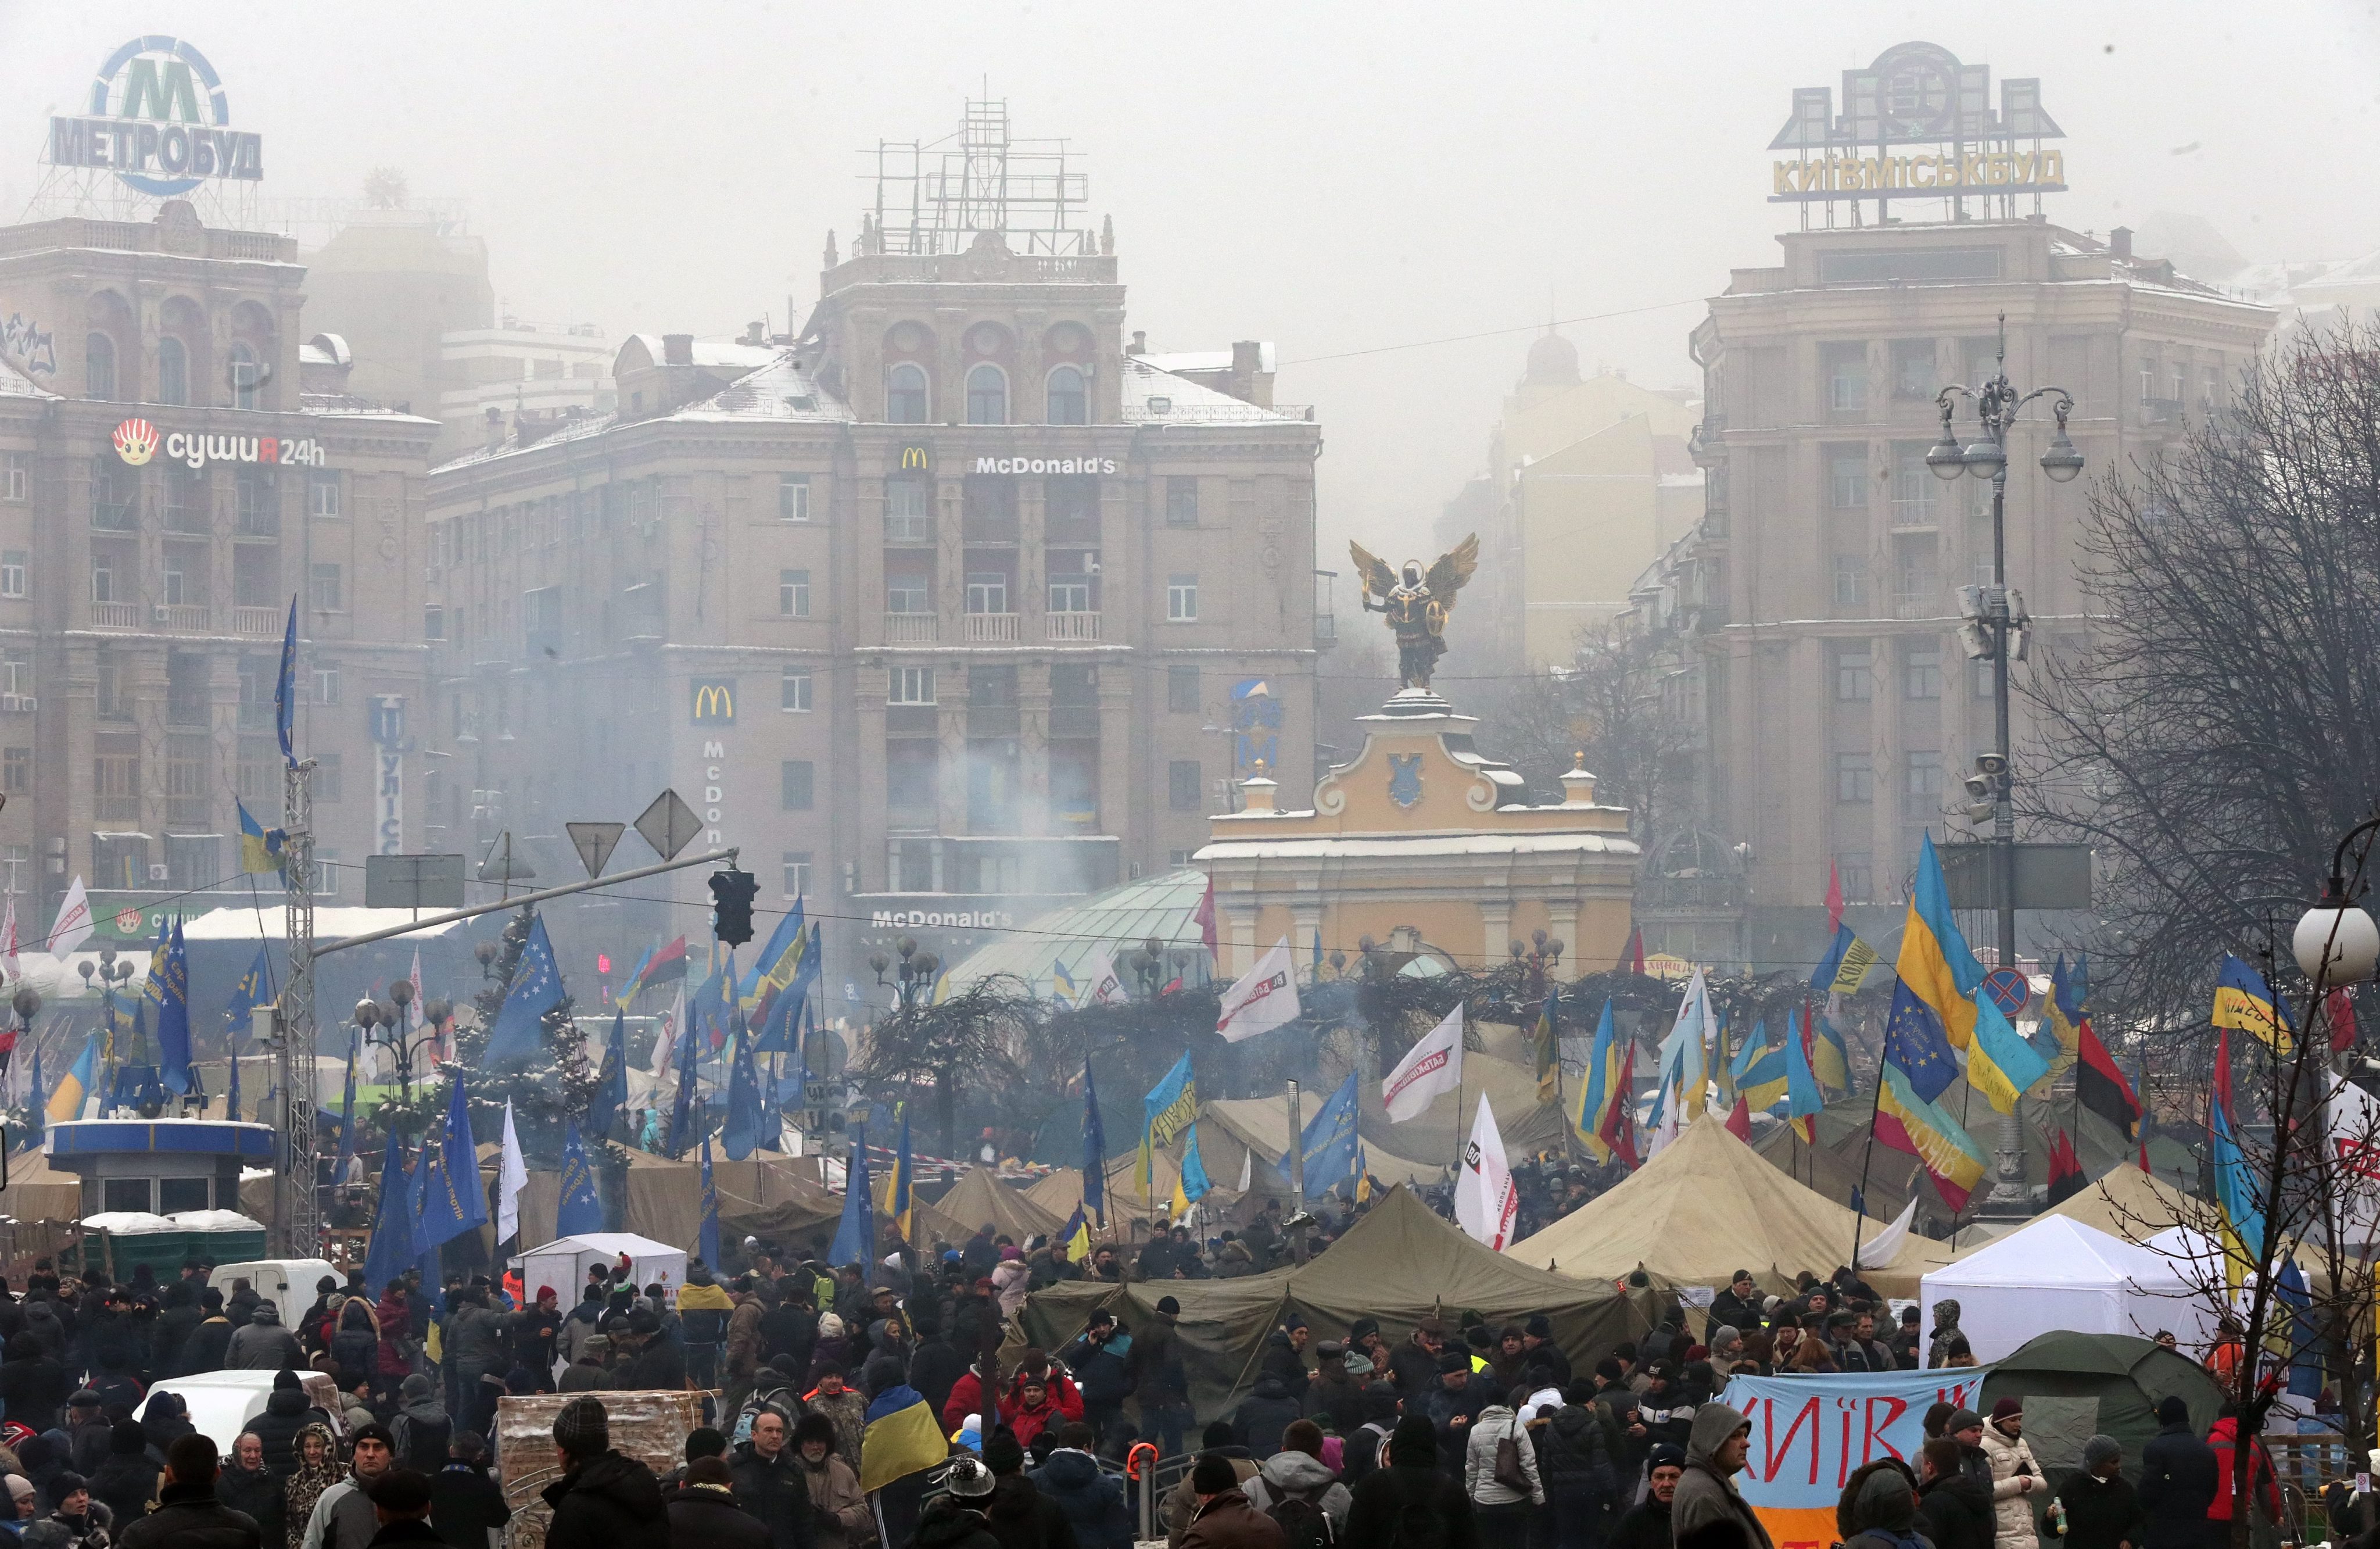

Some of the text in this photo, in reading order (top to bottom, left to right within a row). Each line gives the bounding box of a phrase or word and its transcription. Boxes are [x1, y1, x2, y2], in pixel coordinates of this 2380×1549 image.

[50, 116, 263, 181] МЕТРОБУД
[1773, 149, 2066, 196] КИЇВМІСЬКБУД
[976, 457, 1116, 475] McDonald's
[872, 910, 1013, 929] McDonald's
[1467, 1146, 1481, 1165] ВО
